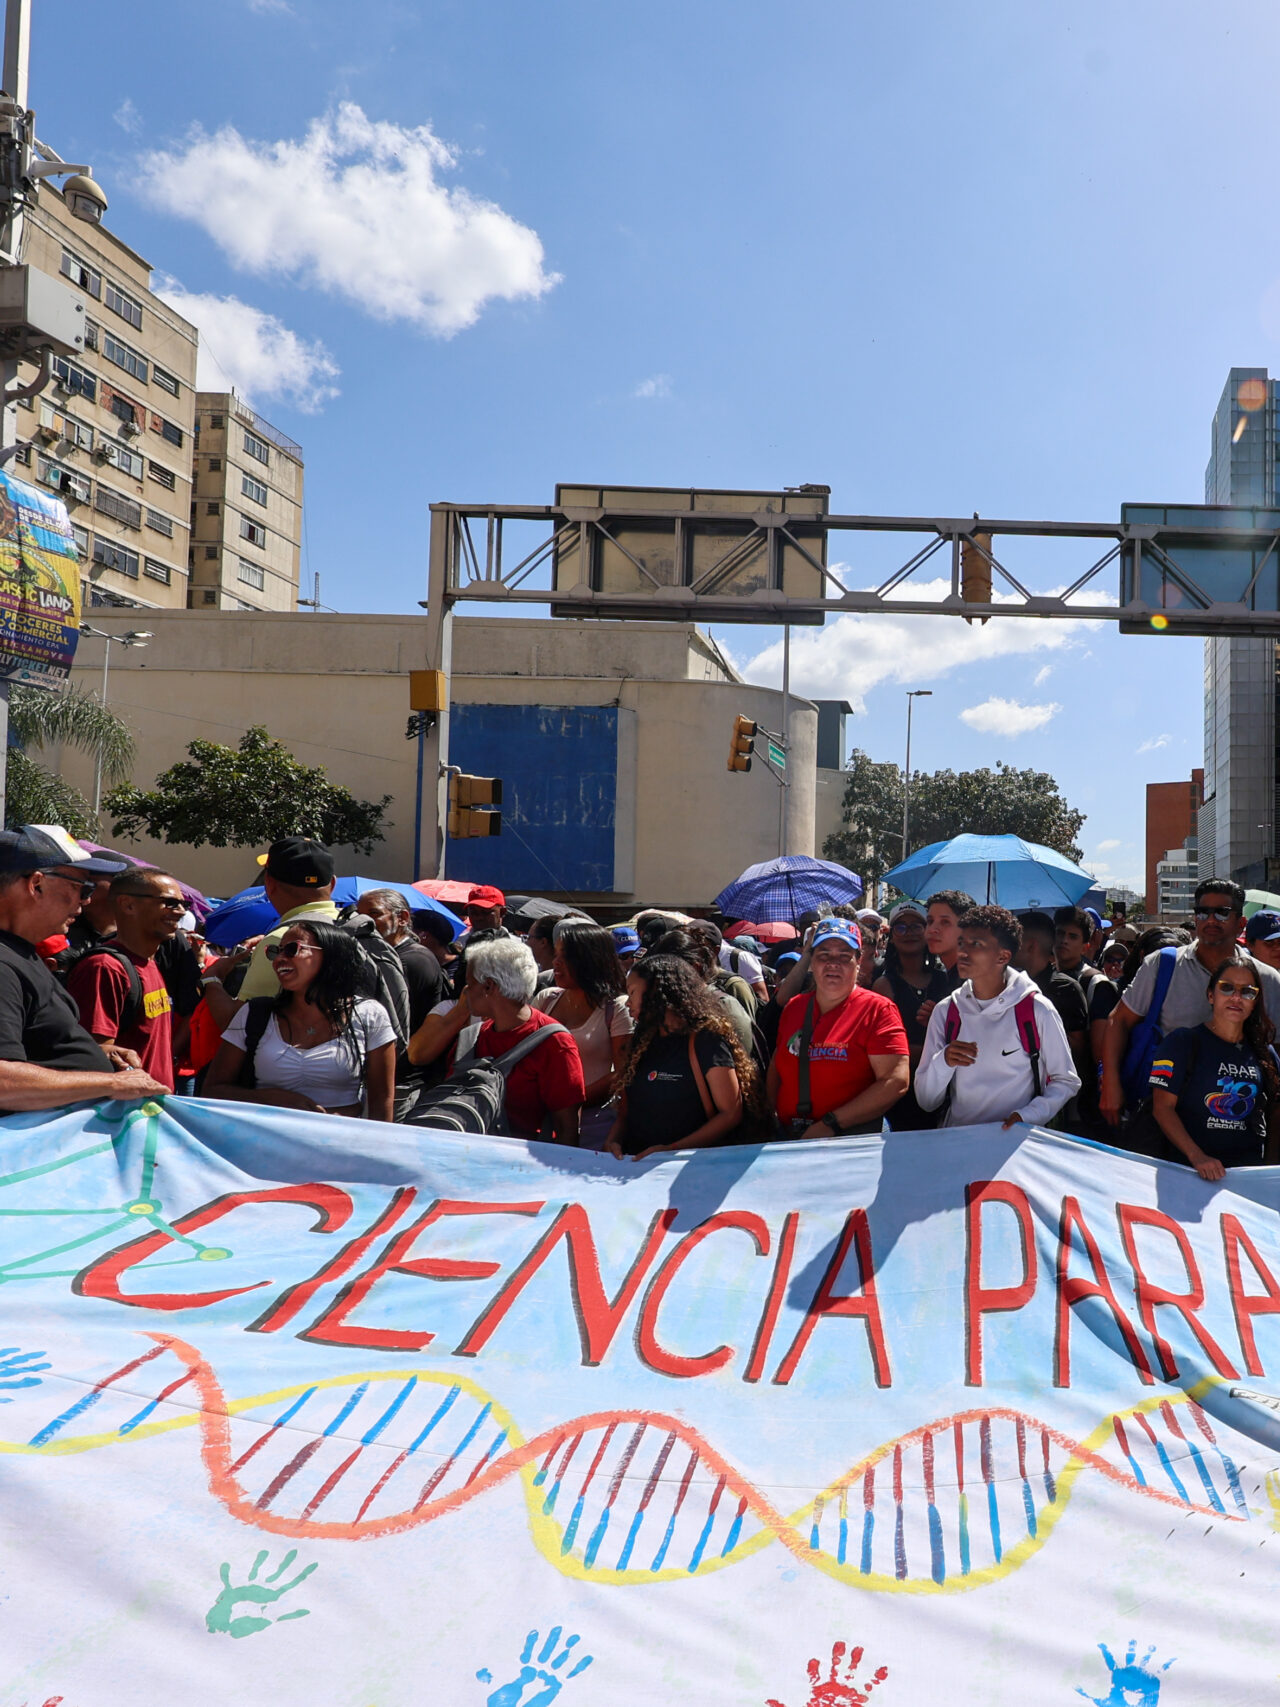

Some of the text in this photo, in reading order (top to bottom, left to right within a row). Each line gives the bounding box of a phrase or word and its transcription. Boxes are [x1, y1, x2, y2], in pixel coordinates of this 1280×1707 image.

[40, 591, 71, 612] LAND
[808, 1047, 849, 1057] IENCIA
[1219, 1062, 1258, 1077] ABAE
[72, 1182, 892, 1389] CIENCIA
